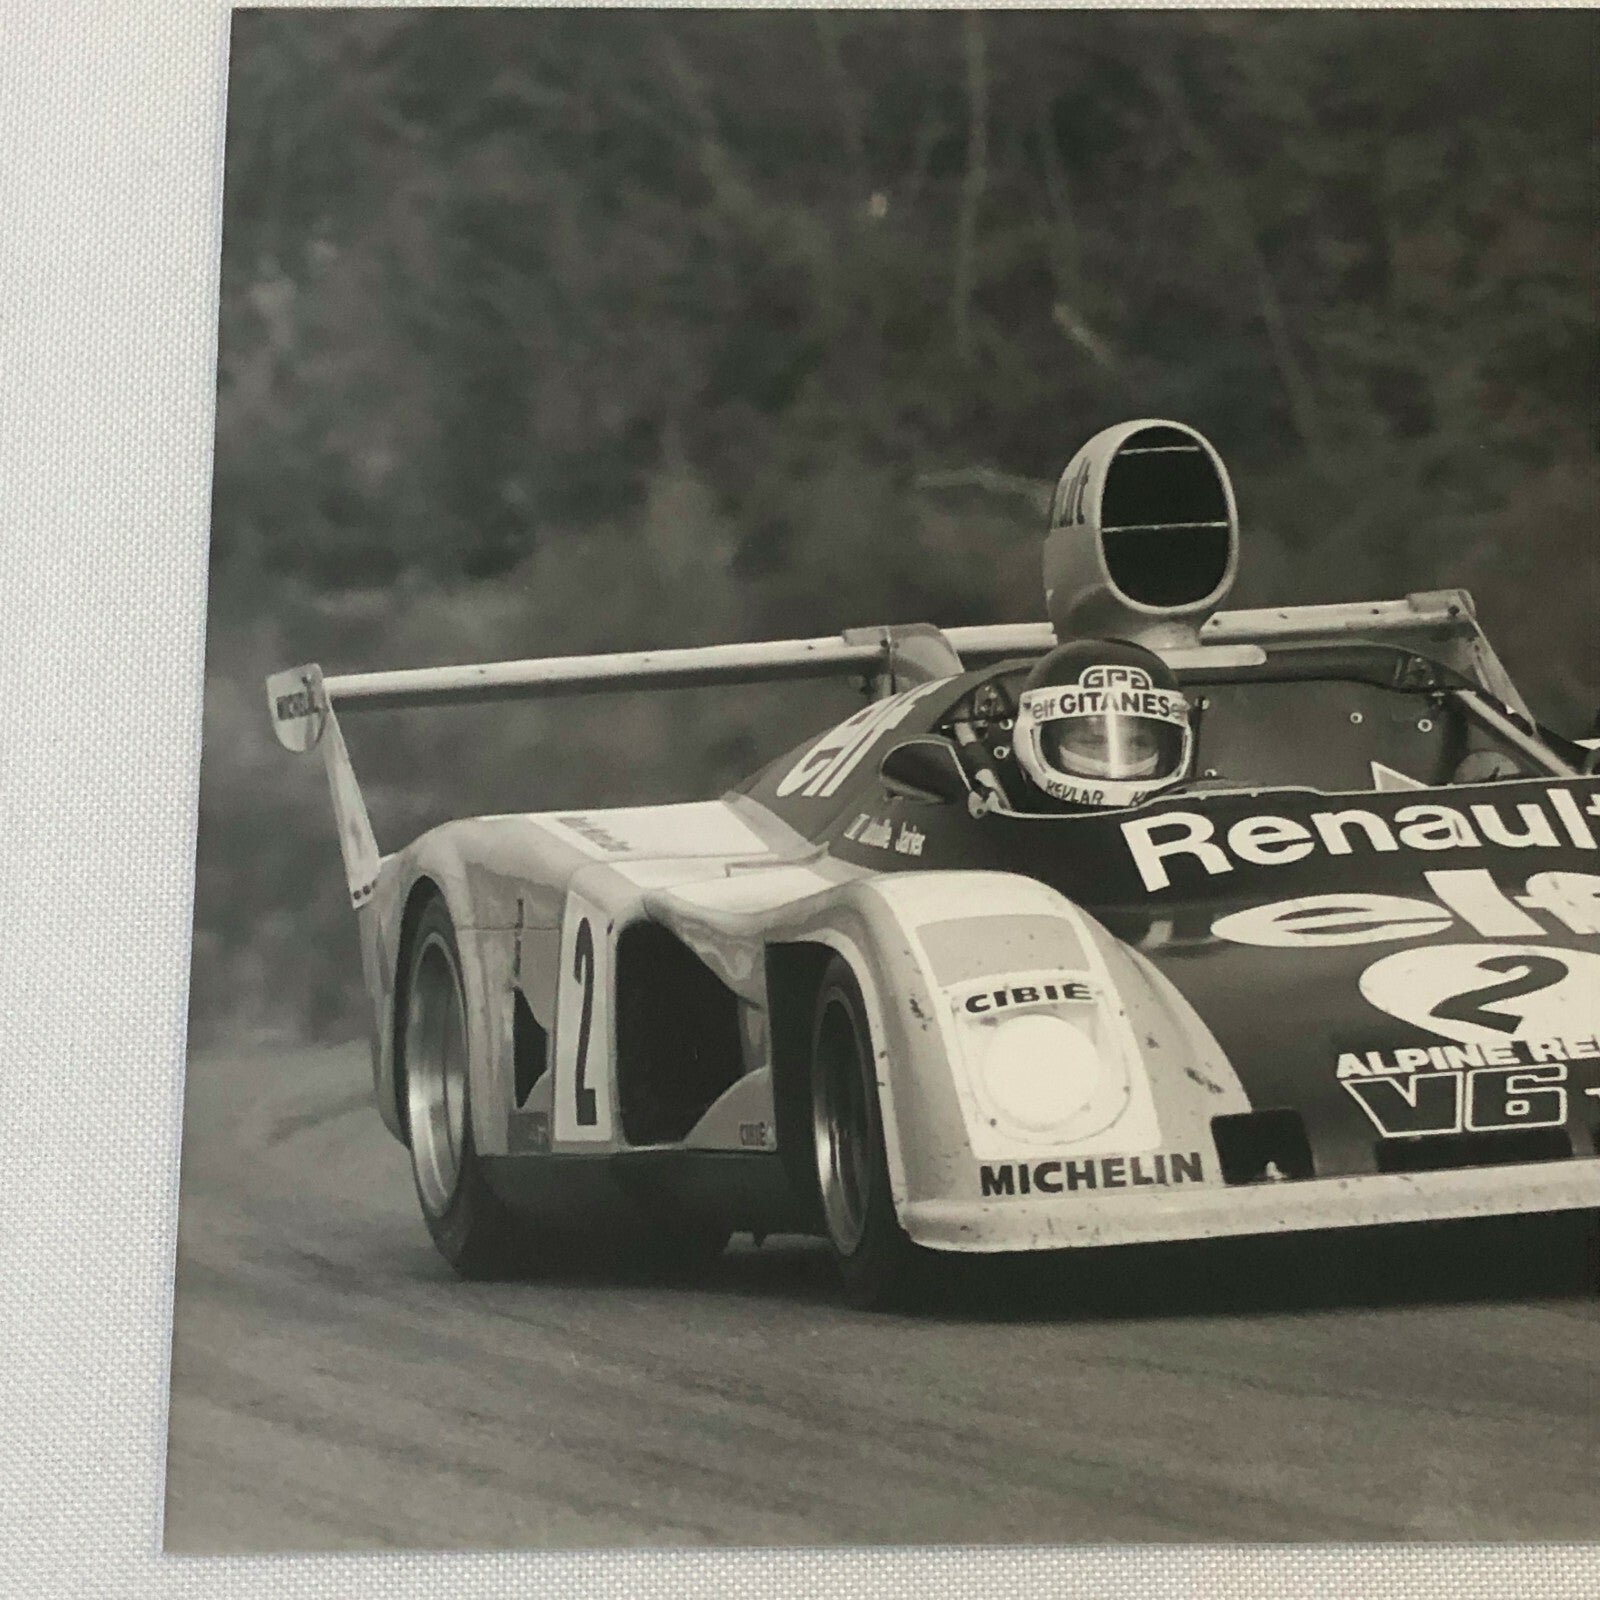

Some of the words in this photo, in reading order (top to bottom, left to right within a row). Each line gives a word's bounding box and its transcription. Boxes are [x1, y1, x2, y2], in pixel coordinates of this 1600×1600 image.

[1059, 691, 1170, 717] GITANES
[1120, 788, 1600, 892] Renaul
[1210, 868, 1600, 947] elf
[574, 917, 597, 1125] 2
[965, 983, 1092, 1013] CIBIE
[1429, 955, 1569, 1034] 2
[1336, 1040, 1521, 1079] ALPINE
[1526, 1034, 1600, 1062] RE
[1340, 1063, 1568, 1138] V6
[980, 1152, 1203, 1196] MICHELIN
